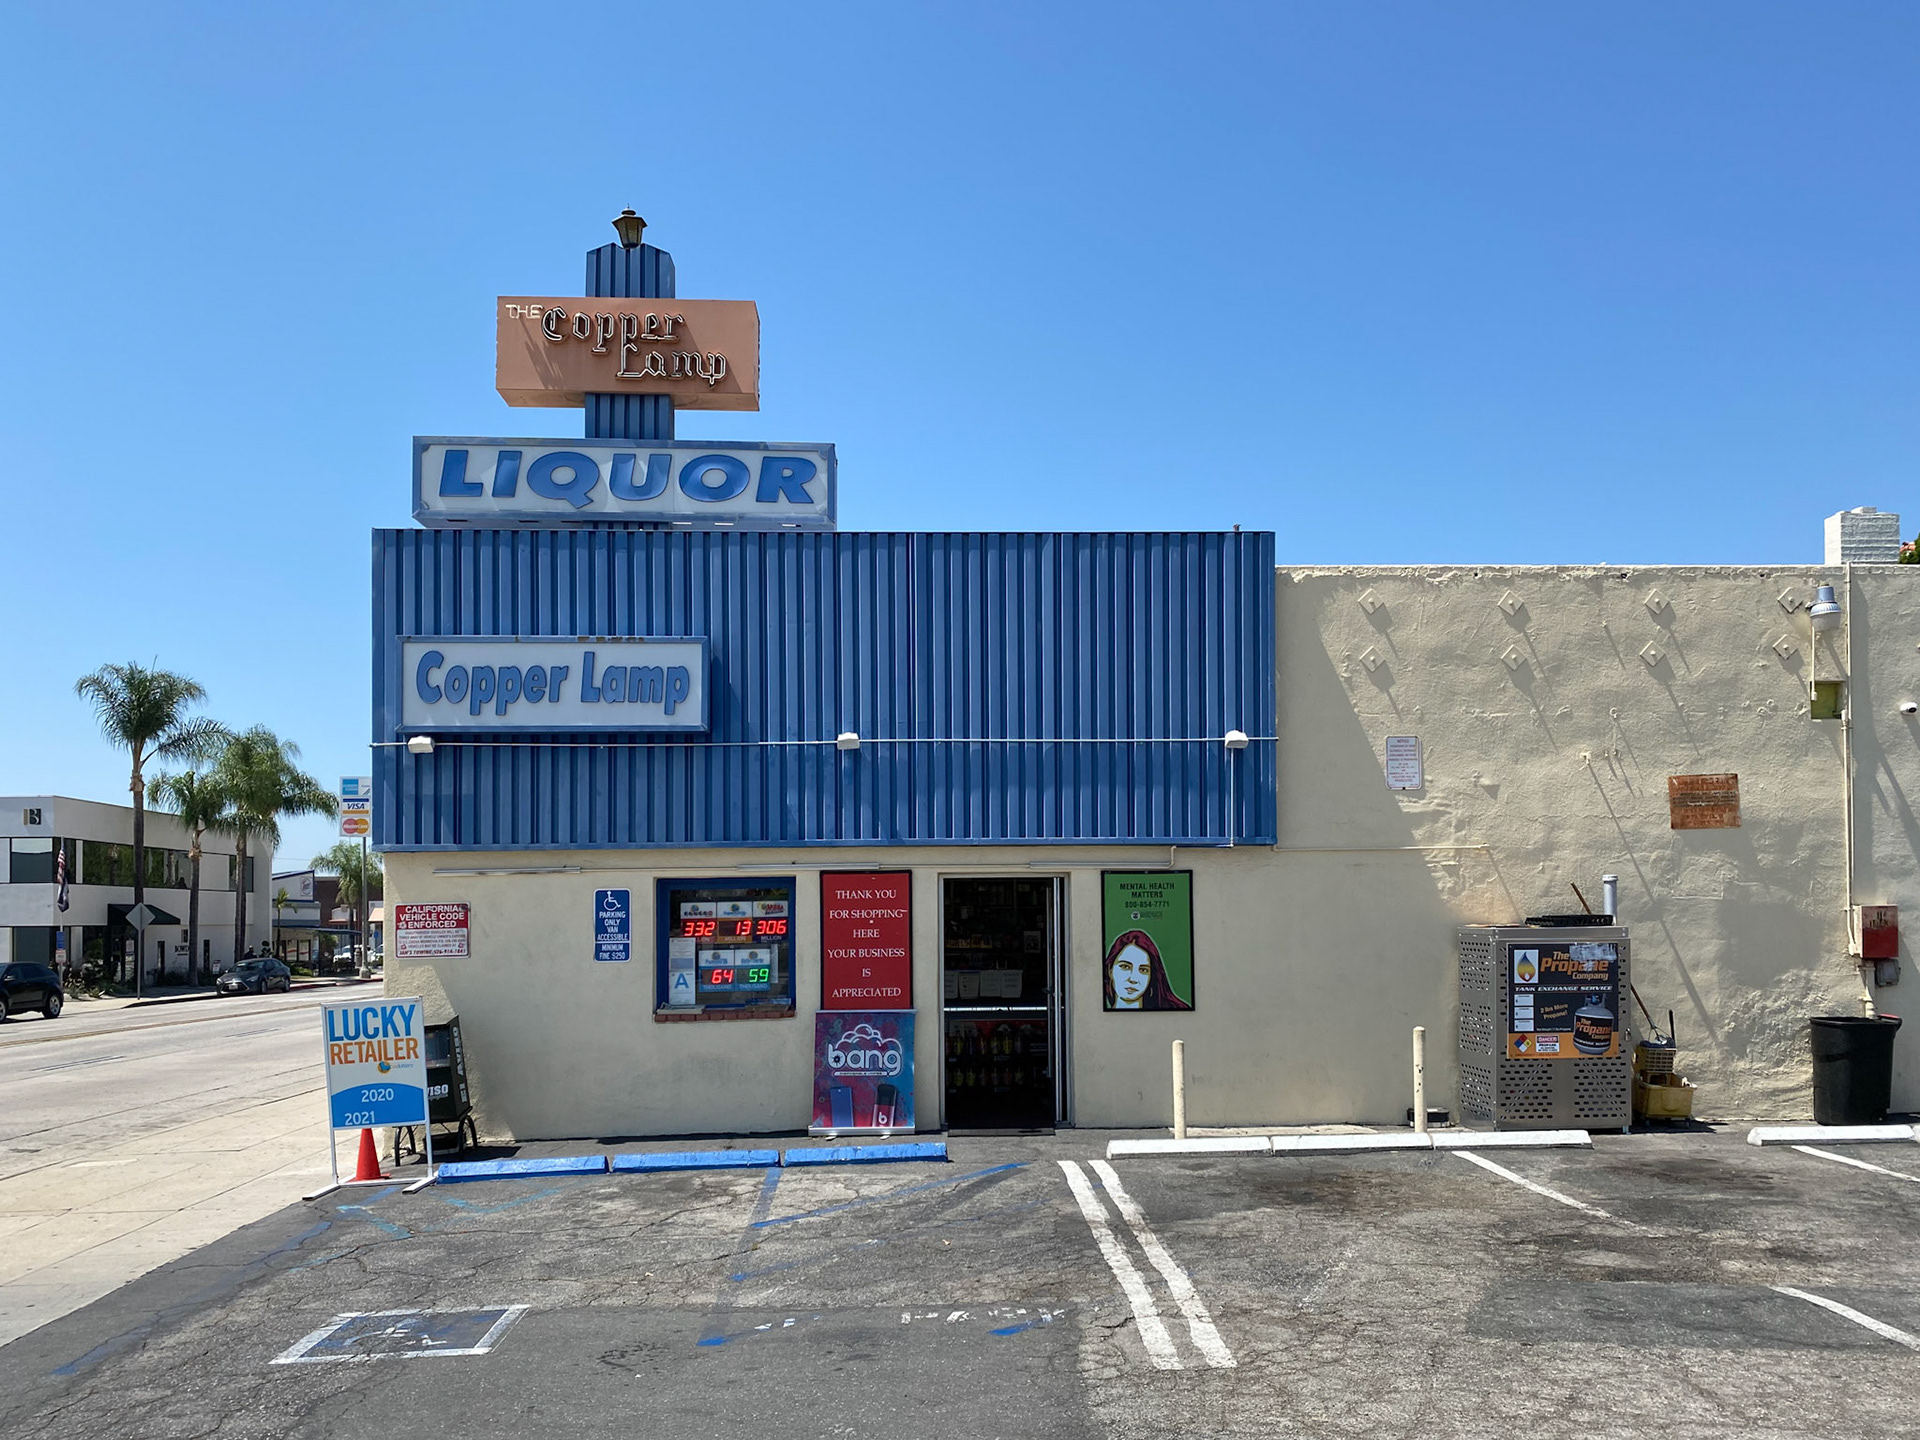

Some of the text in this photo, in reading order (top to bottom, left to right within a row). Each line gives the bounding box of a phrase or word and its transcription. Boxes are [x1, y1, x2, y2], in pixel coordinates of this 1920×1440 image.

[505, 303, 544, 319] THE
[540, 305, 686, 353] Copper
[615, 342, 728, 386] Lamp
[439, 449, 818, 509] LIQUOR
[416, 650, 690, 716] Copper Lamp
[835, 890, 897, 899] THANK YOU
[405, 905, 459, 913] CALIFORNIA
[439, 912, 465, 920] CODE
[599, 911, 626, 919] PARKING
[829, 909, 903, 919] FOR SHOPPING
[408, 921, 457, 929] ENFORCED
[684, 922, 716, 936] 332
[735, 920, 752, 935] 13
[756, 920, 787, 935] 306
[853, 929, 880, 938] HERE
[600, 952, 610, 960] FINE
[828, 948, 905, 958] YOUR BUSINESS
[1553, 951, 1570, 960] The
[711, 969, 734, 983] 64
[749, 968, 769, 983] 59
[862, 968, 871, 977] IS
[1572, 972, 1609, 981] Company
[674, 973, 689, 989] A
[832, 988, 901, 998] APPRECIATED
[327, 1004, 416, 1042] LUCKY
[330, 1037, 420, 1065] RETAILER
[827, 1043, 903, 1076] bang
[361, 1088, 395, 1103] 2020
[344, 1110, 376, 1126] 2021
